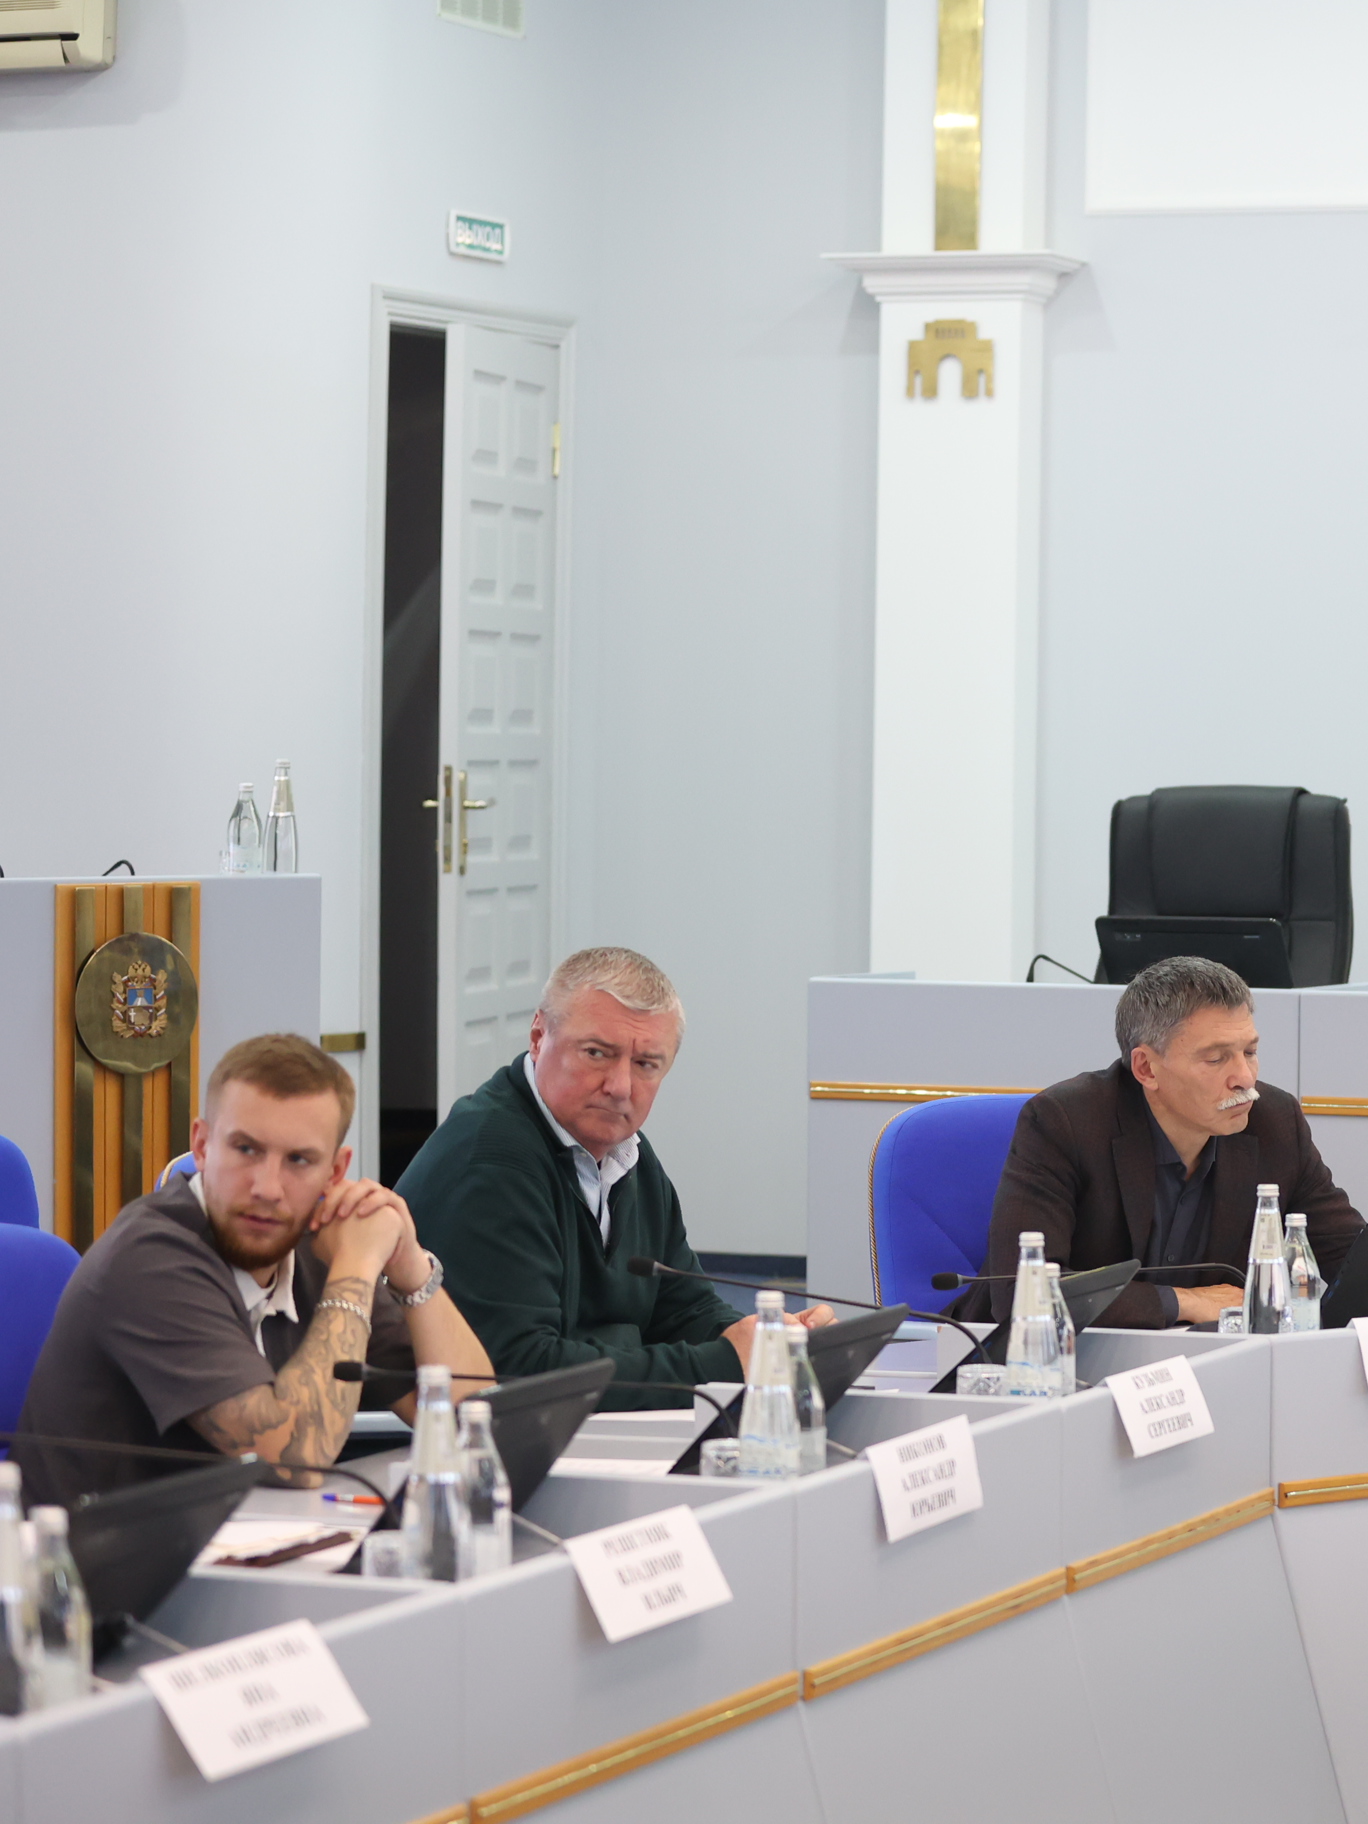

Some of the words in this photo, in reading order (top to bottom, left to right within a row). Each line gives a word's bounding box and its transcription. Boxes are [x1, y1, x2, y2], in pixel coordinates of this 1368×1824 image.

[456, 220, 503, 250] ВЫХОД
[1139, 1389, 1186, 1414] АЛЕКСАНДР
[1147, 1412, 1194, 1439] СЕРГЕЕВИЧ
